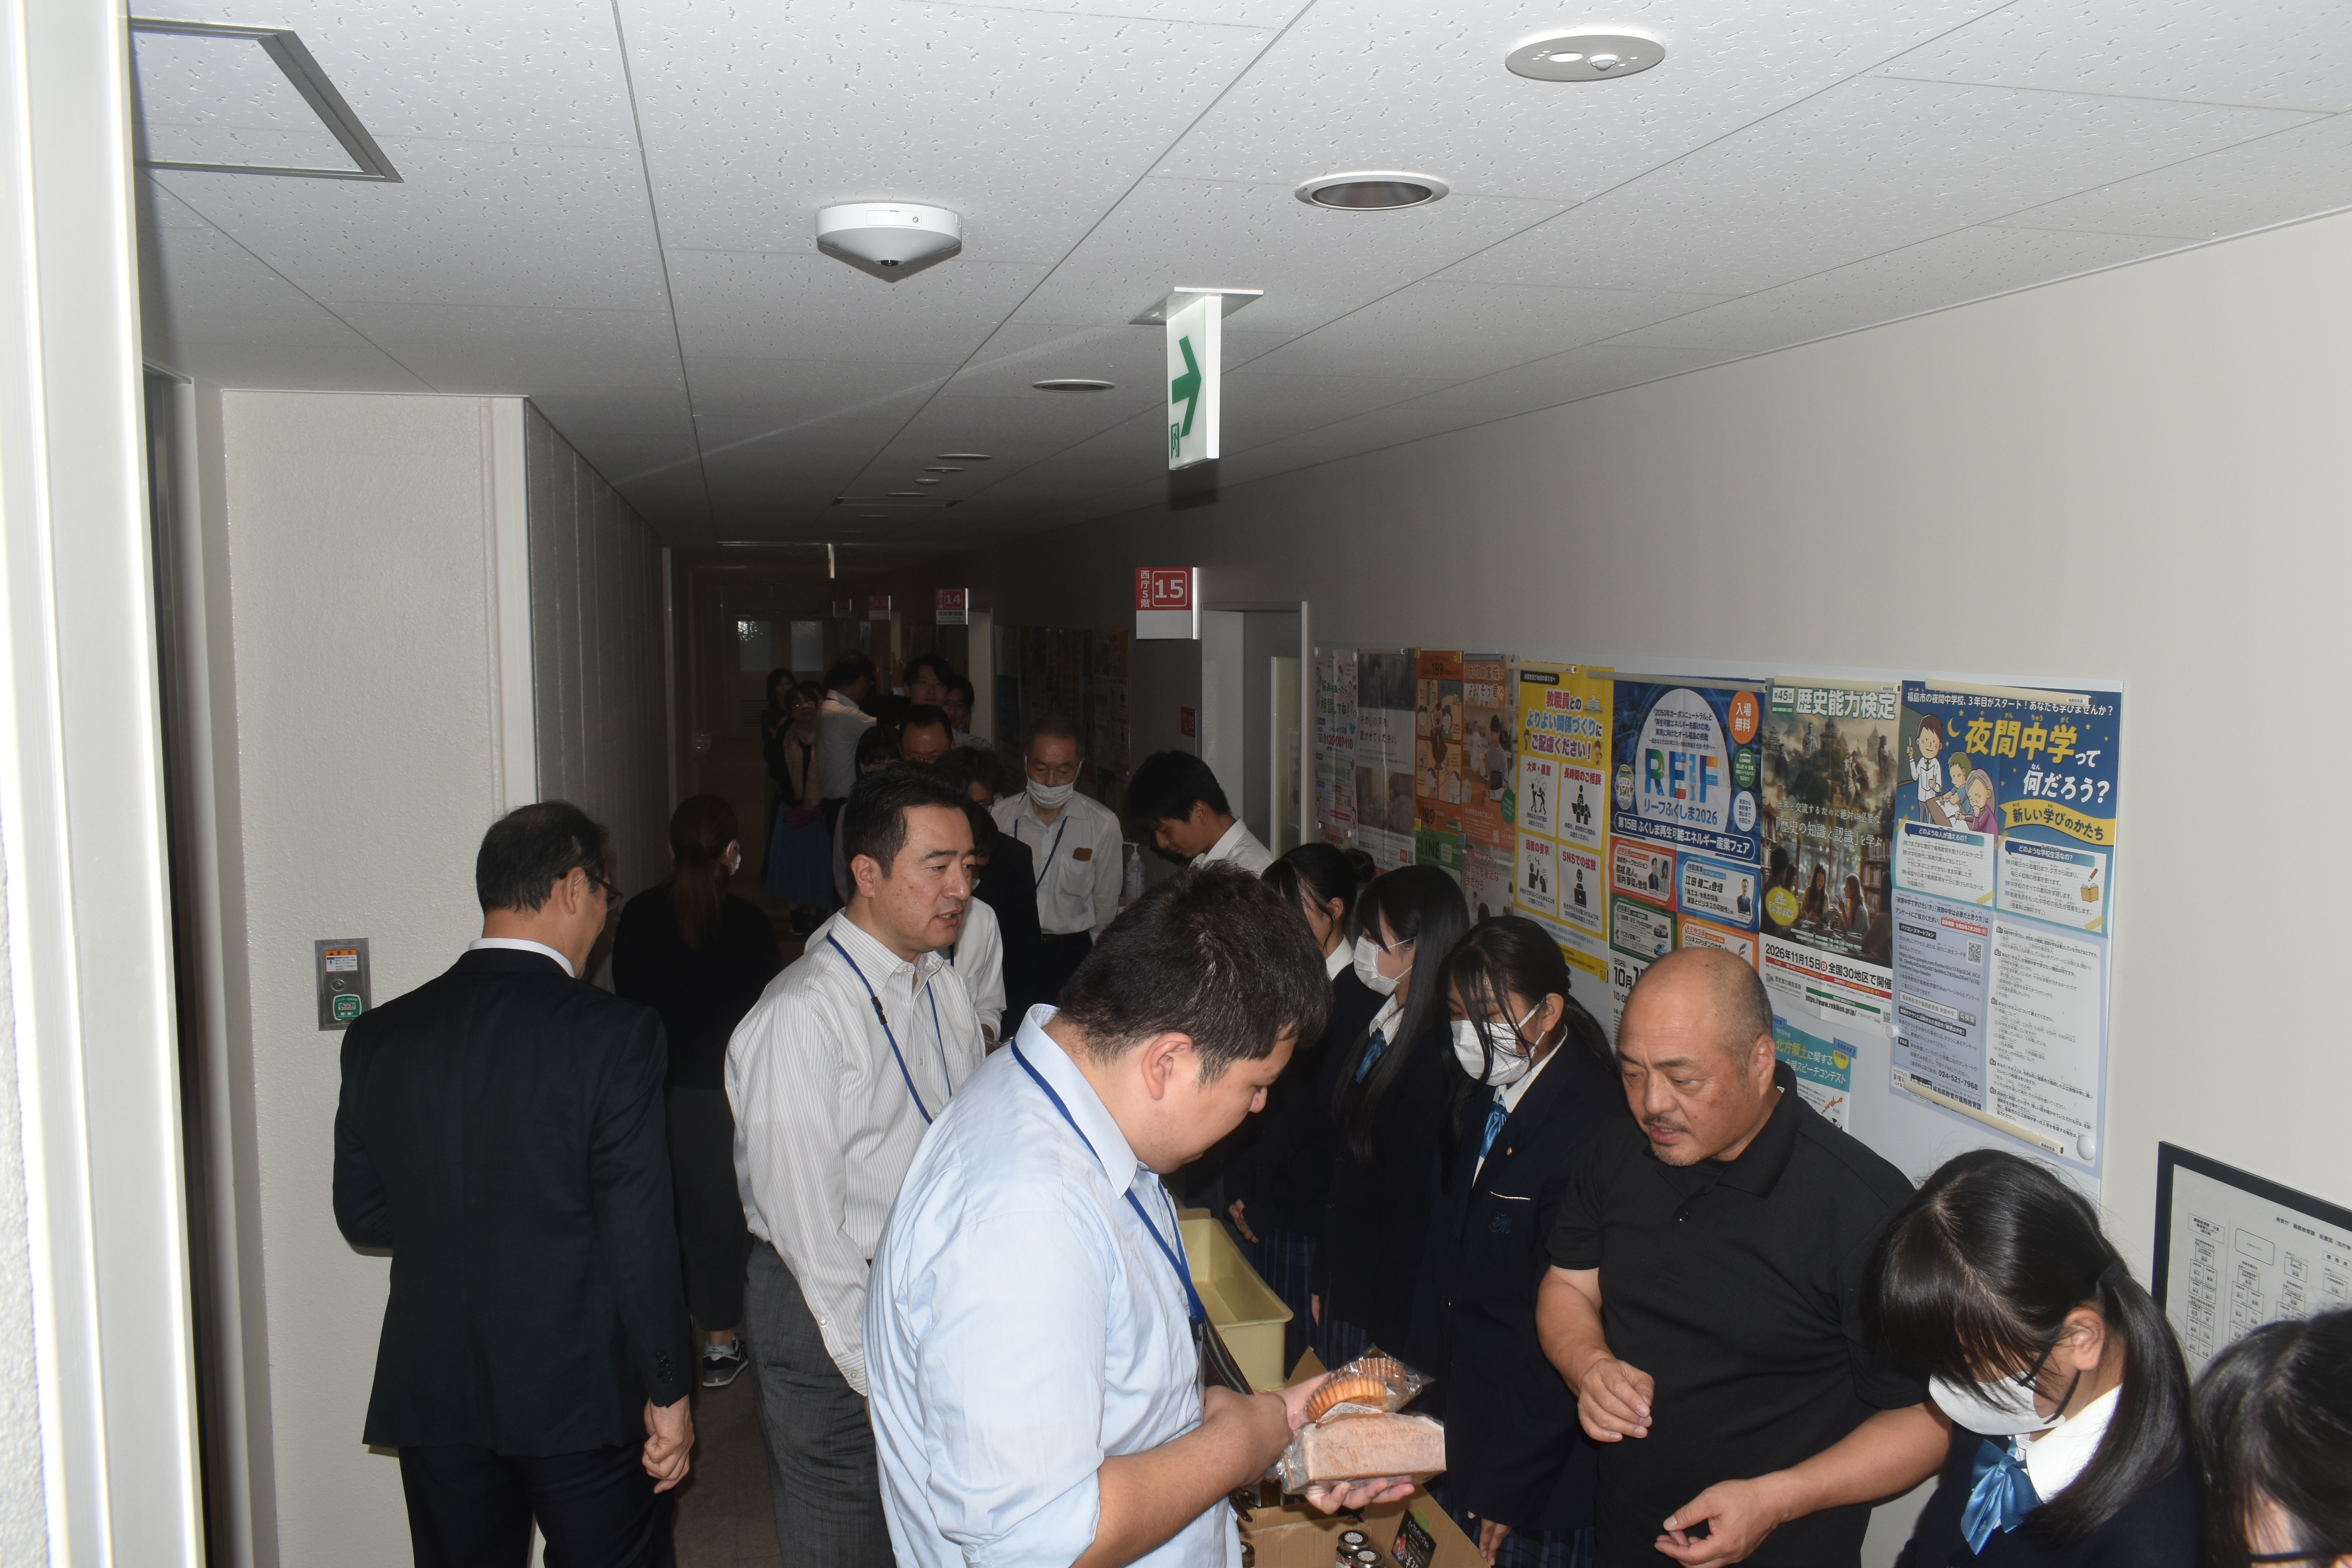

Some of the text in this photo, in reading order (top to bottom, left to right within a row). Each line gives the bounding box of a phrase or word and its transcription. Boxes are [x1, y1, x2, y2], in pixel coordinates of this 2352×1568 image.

[1140, 570, 1150, 608] 西庁5階
[1155, 579, 1184, 599] 15
[946, 594, 961, 604] 14
[1432, 662, 1444, 675] 189
[1468, 664, 1505, 681] 大切な家族に
[1468, 684, 1504, 698] よりそう君へ
[1773, 690, 1793, 701] 第45回
[1546, 690, 1582, 711] 教職員との
[1736, 702, 1751, 717] 入場
[1796, 688, 1896, 720] 歴史能力検定
[1361, 715, 1388, 728] その心の声を、
[1526, 710, 1603, 737] よりよい関係づくりに
[1735, 718, 1751, 732] 無料
[1360, 730, 1397, 744] 聴かせてください。
[1965, 716, 2101, 768] 夜間中学って
[1531, 734, 1592, 760] ご配慮ください！
[1527, 762, 1551, 776] 大声・暴言
[1564, 767, 1602, 786] 長時間のご相談
[1619, 785, 1630, 796] 150
[2024, 769, 2110, 804] 何だろう？
[1644, 799, 1718, 826] リーフふくしま2026
[1777, 800, 1881, 824] 世界と交流するために絶対に必要な
[1775, 816, 1883, 848] 「歴史の知識と認識」を学ぶ
[2013, 808, 2103, 841] 新しい学びのかたち
[1618, 817, 1750, 855] 第15回 ふくしま再生可能エネルギー産業フェア
[1919, 828, 1967, 842] どのような人が通えるの？
[1420, 837, 1440, 860] LINE
[1526, 839, 1550, 856] 過度の要求
[1908, 841, 1984, 860] さまざまな理由で義務教育を受けられなかった方
[2018, 845, 2073, 861] どのような学校生活なの？
[1562, 850, 1597, 872] SNSでの拡散
[1907, 861, 1972, 878] 十分に学ぶことができないまま卒業した方
[2011, 860, 2079, 879] 月曜日から金曜日まで、夕方から始まり、
[1466, 861, 1499, 882] 誰にでも身近な
[1685, 875, 1697, 886] 江田
[1907, 870, 1984, 891] 母国や日本で義務教育を十分に受けられなかった
[2010, 871, 2062, 886] 毎日4校時の授業を受けます。
[1465, 875, 1485, 891] 今だから
[1907, 880, 1925, 888] 外国籍の方
[2010, 882, 2073, 900] 中学校のすべての教科を学習します。
[1895, 896, 1989, 923] 「夜間中学で学びたい方」「夜間中学は必要だと思う方」は
[2010, 892, 2092, 916] 教員免許をもった中学校の先生が授業をします。
[1895, 908, 1940, 924] アンケートにご協力ください。
[1901, 925, 1935, 938] パソコン・スマートフォン
[1614, 957, 1626, 968] 2026
[1765, 943, 1821, 970] 2026年11月15日
[1828, 962, 1892, 990] 全国30地区で開催
[1613, 966, 1632, 990] 10月
[1939, 1006, 1955, 1017] 夜間中学
[1965, 1014, 1975, 1024] 検索
[1775, 1038, 1833, 1065] 北方領土に関する
[1938, 1070, 1978, 1091] 024-521-7968
[2293, 1223, 2316, 1236] 義務教育課
